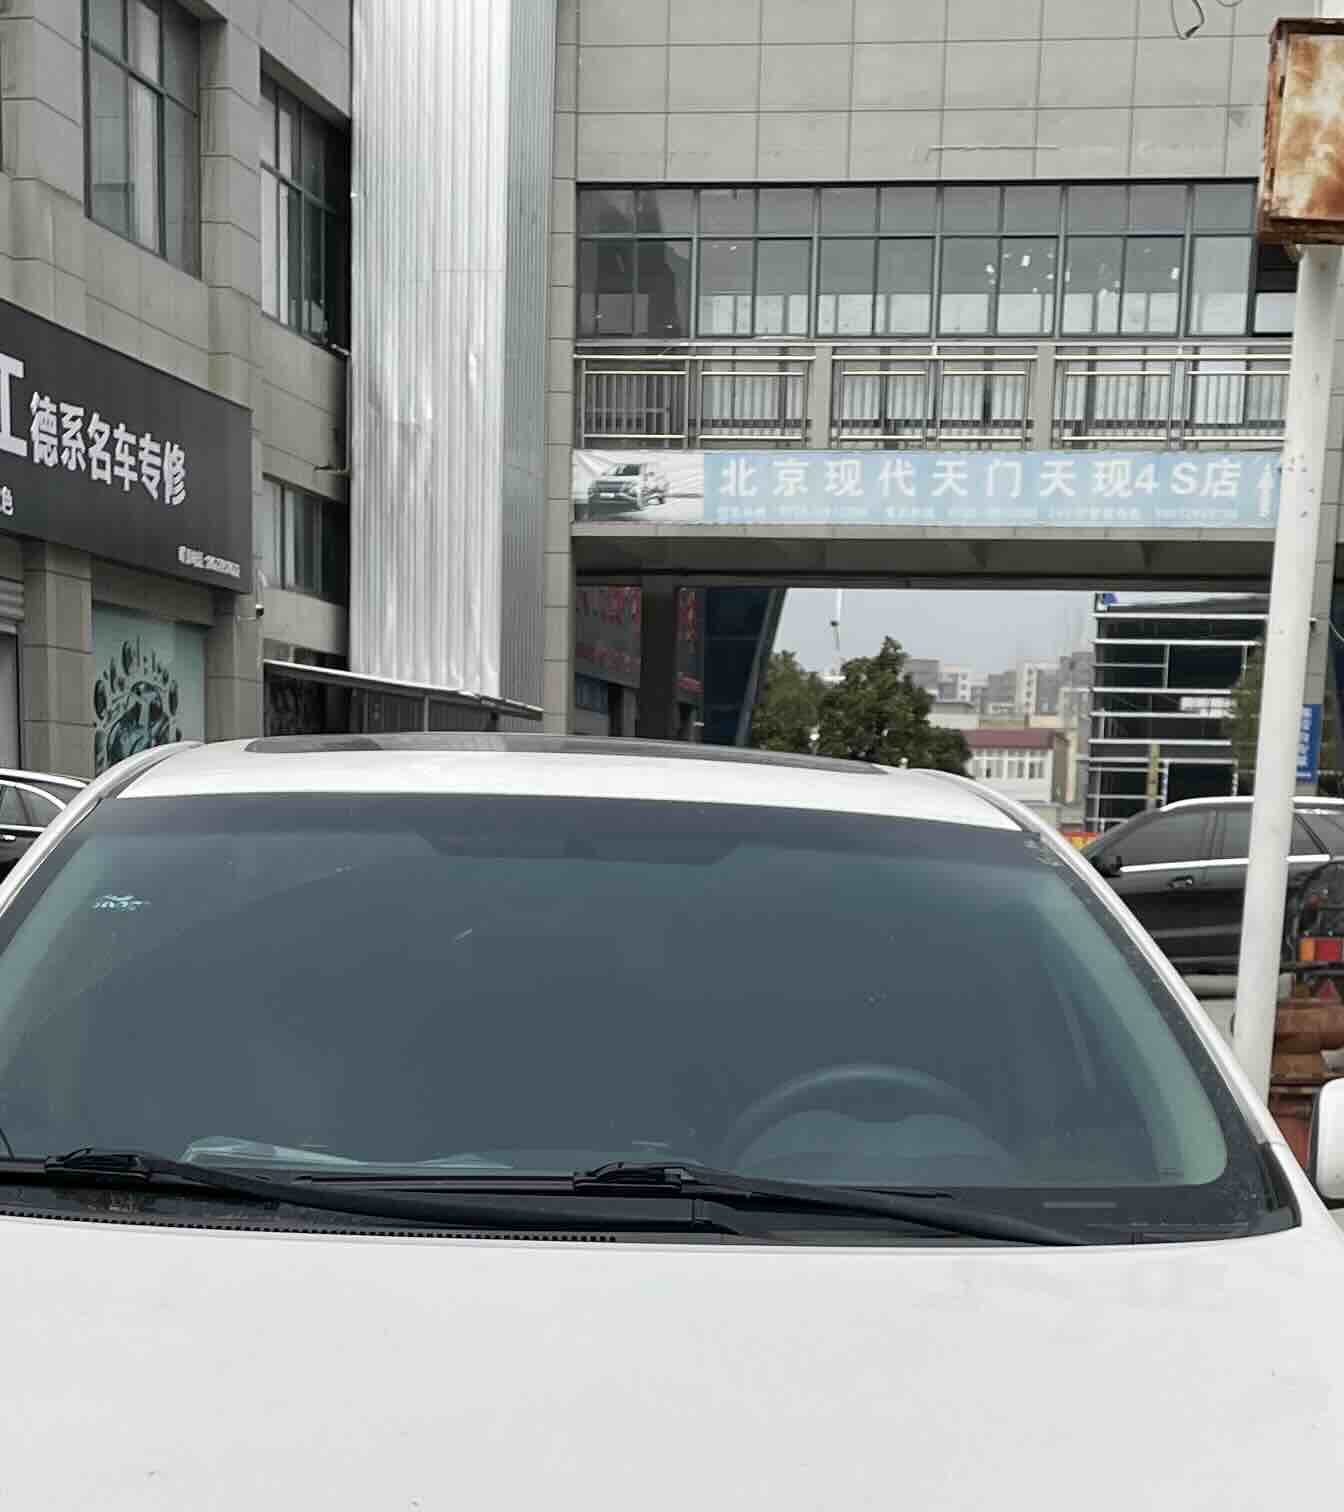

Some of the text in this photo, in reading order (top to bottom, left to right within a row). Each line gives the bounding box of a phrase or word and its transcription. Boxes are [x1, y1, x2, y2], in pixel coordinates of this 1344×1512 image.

[30, 391, 187, 506] 德系名车专修
